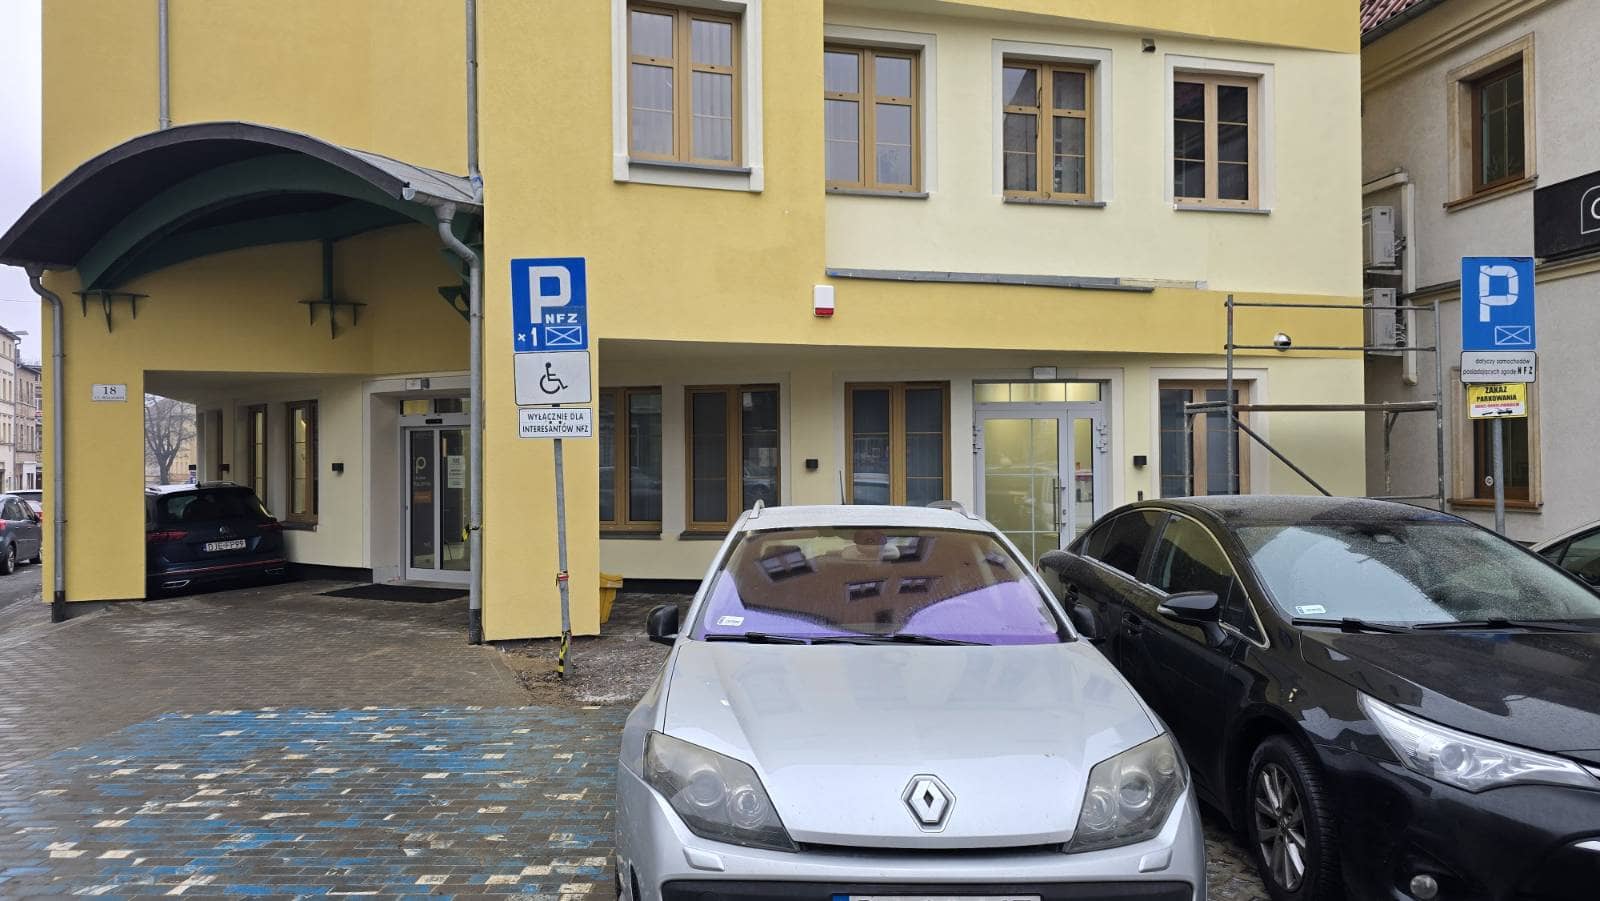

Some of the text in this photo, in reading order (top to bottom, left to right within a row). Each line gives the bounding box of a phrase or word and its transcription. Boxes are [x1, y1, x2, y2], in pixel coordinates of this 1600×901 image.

[528, 265, 572, 324] P
[1479, 265, 1519, 322] P
[545, 313, 578, 324] NFZ
[104, 386, 117, 395] 18
[1485, 386, 1508, 394] ZAKAZ
[1476, 394, 1517, 403] PARKOWANIA
[570, 412, 584, 421] DLA
[522, 422, 589, 433] INTERESANTÓW NFZ
